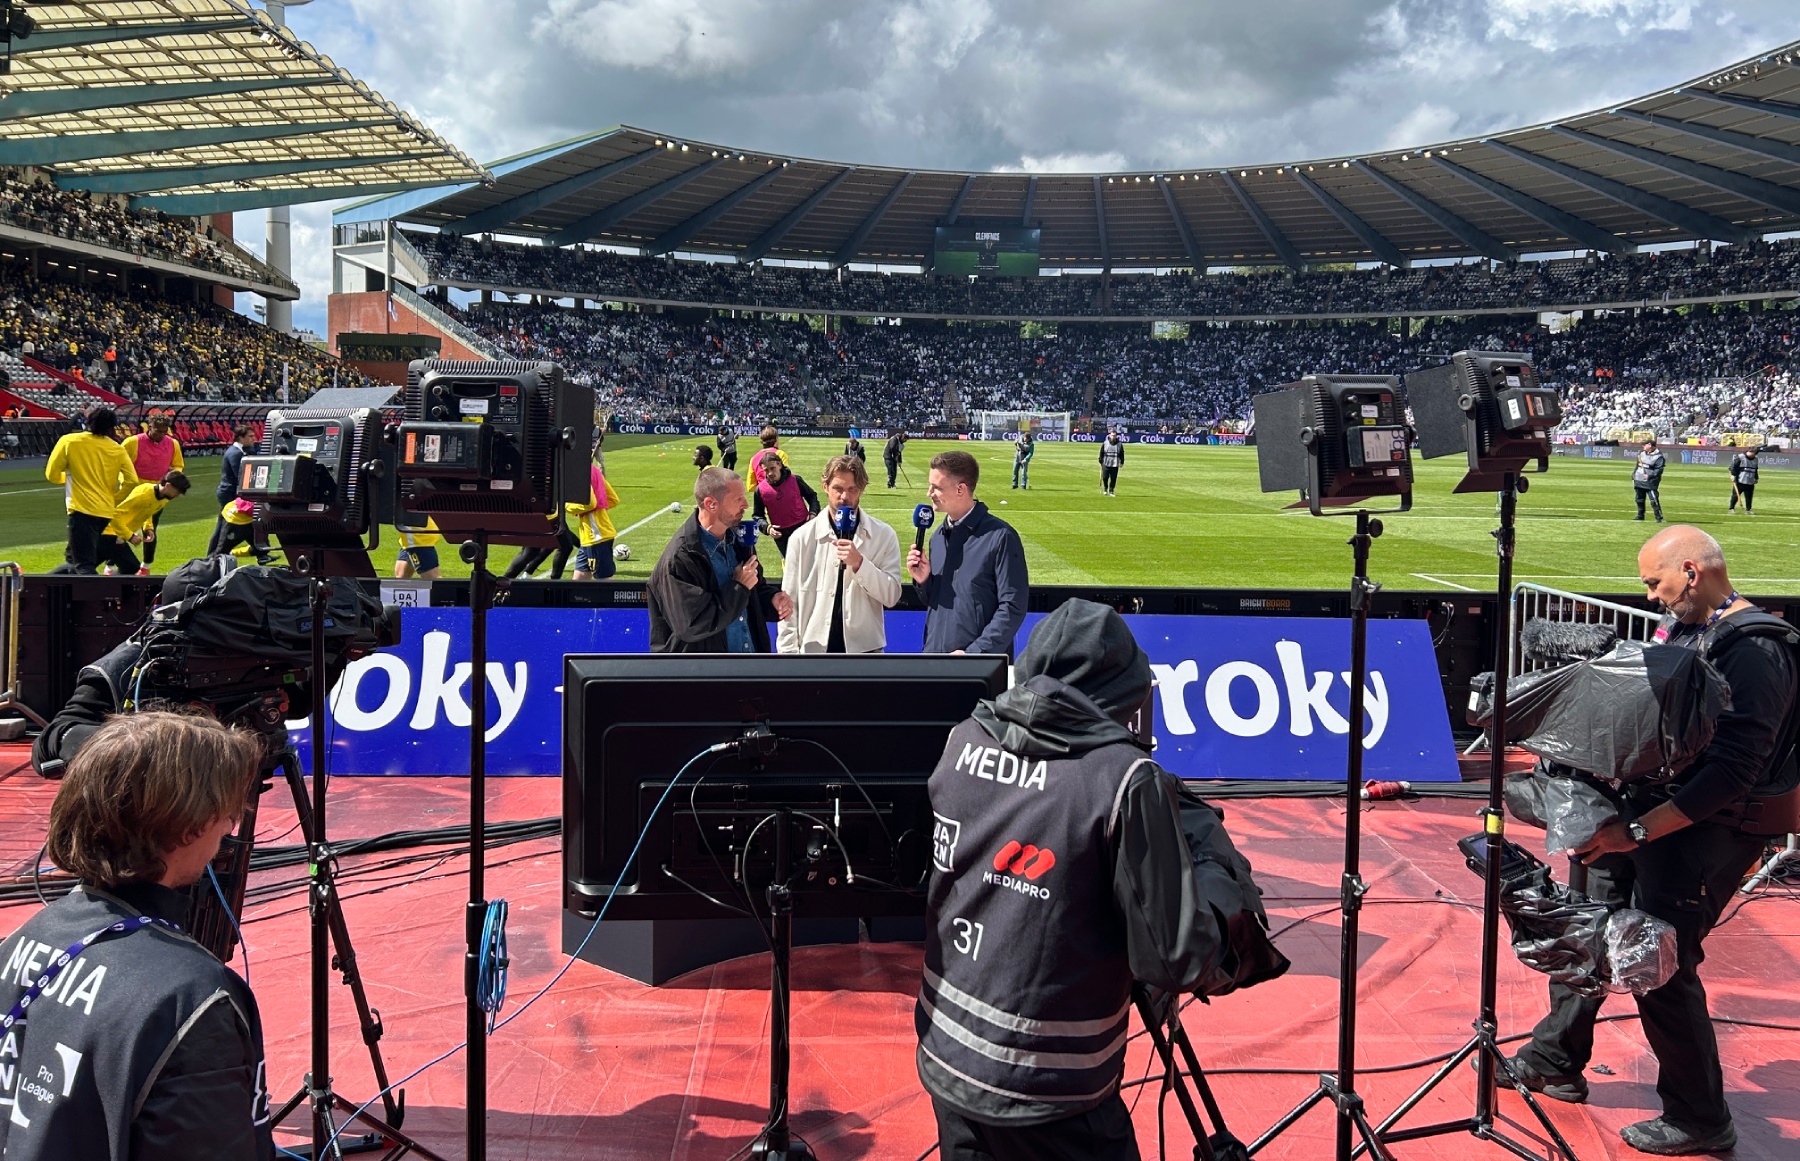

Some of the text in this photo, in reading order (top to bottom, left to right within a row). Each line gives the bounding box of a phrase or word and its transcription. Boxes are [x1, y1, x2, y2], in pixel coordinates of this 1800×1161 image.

[620, 424, 646, 433] Croky
[654, 425, 680, 434] Croky
[688, 425, 714, 435] Croky
[1036, 432, 1062, 442] Croky
[1071, 433, 1096, 442] Croky
[1140, 434, 1165, 444] Croky
[1174, 435, 1200, 445] Croky
[1765, 456, 1790, 465] keuken
[1240, 599, 1290, 607] BRIGHTBOARD
[1150, 641, 1389, 749] roky
[955, 742, 1047, 791] MEDIA
[982, 871, 1050, 900] MEDIAPRO
[952, 917, 984, 962] 31
[37, 1065, 54, 1083] Pro
[21, 1076, 55, 1104] League
